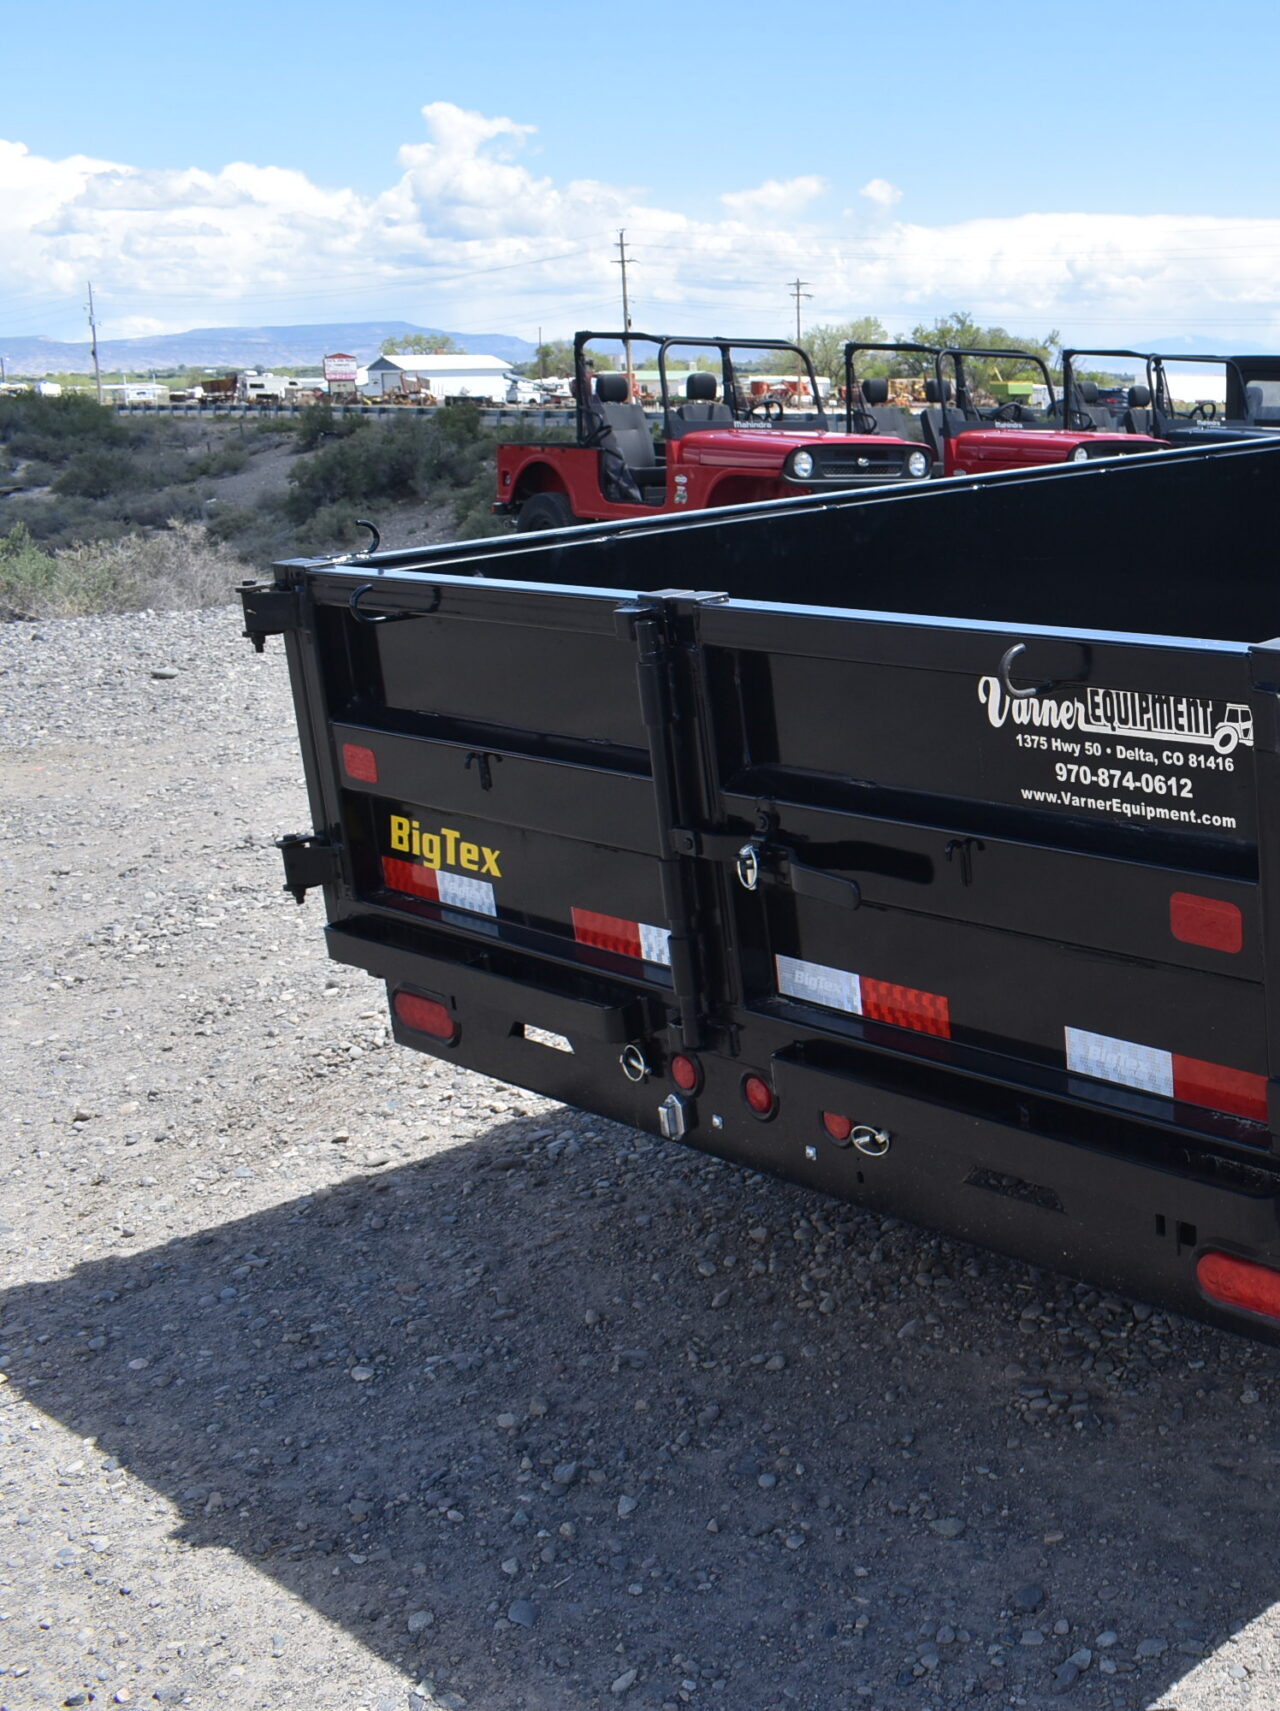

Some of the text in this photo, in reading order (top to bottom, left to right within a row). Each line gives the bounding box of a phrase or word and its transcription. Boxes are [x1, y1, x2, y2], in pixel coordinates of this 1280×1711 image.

[733, 420, 773, 429] Mahindra
[977, 675, 1214, 737] Varner EQUIPMENT
[1016, 733, 1235, 772] 1375 Hwy 50 Delta, CO 81416
[1054, 762, 1194, 799] 970-874-0612
[1020, 787, 1237, 829] www.VarnerEquipment.com
[390, 814, 502, 878] BigTex
[794, 969, 842, 994] BigTex
